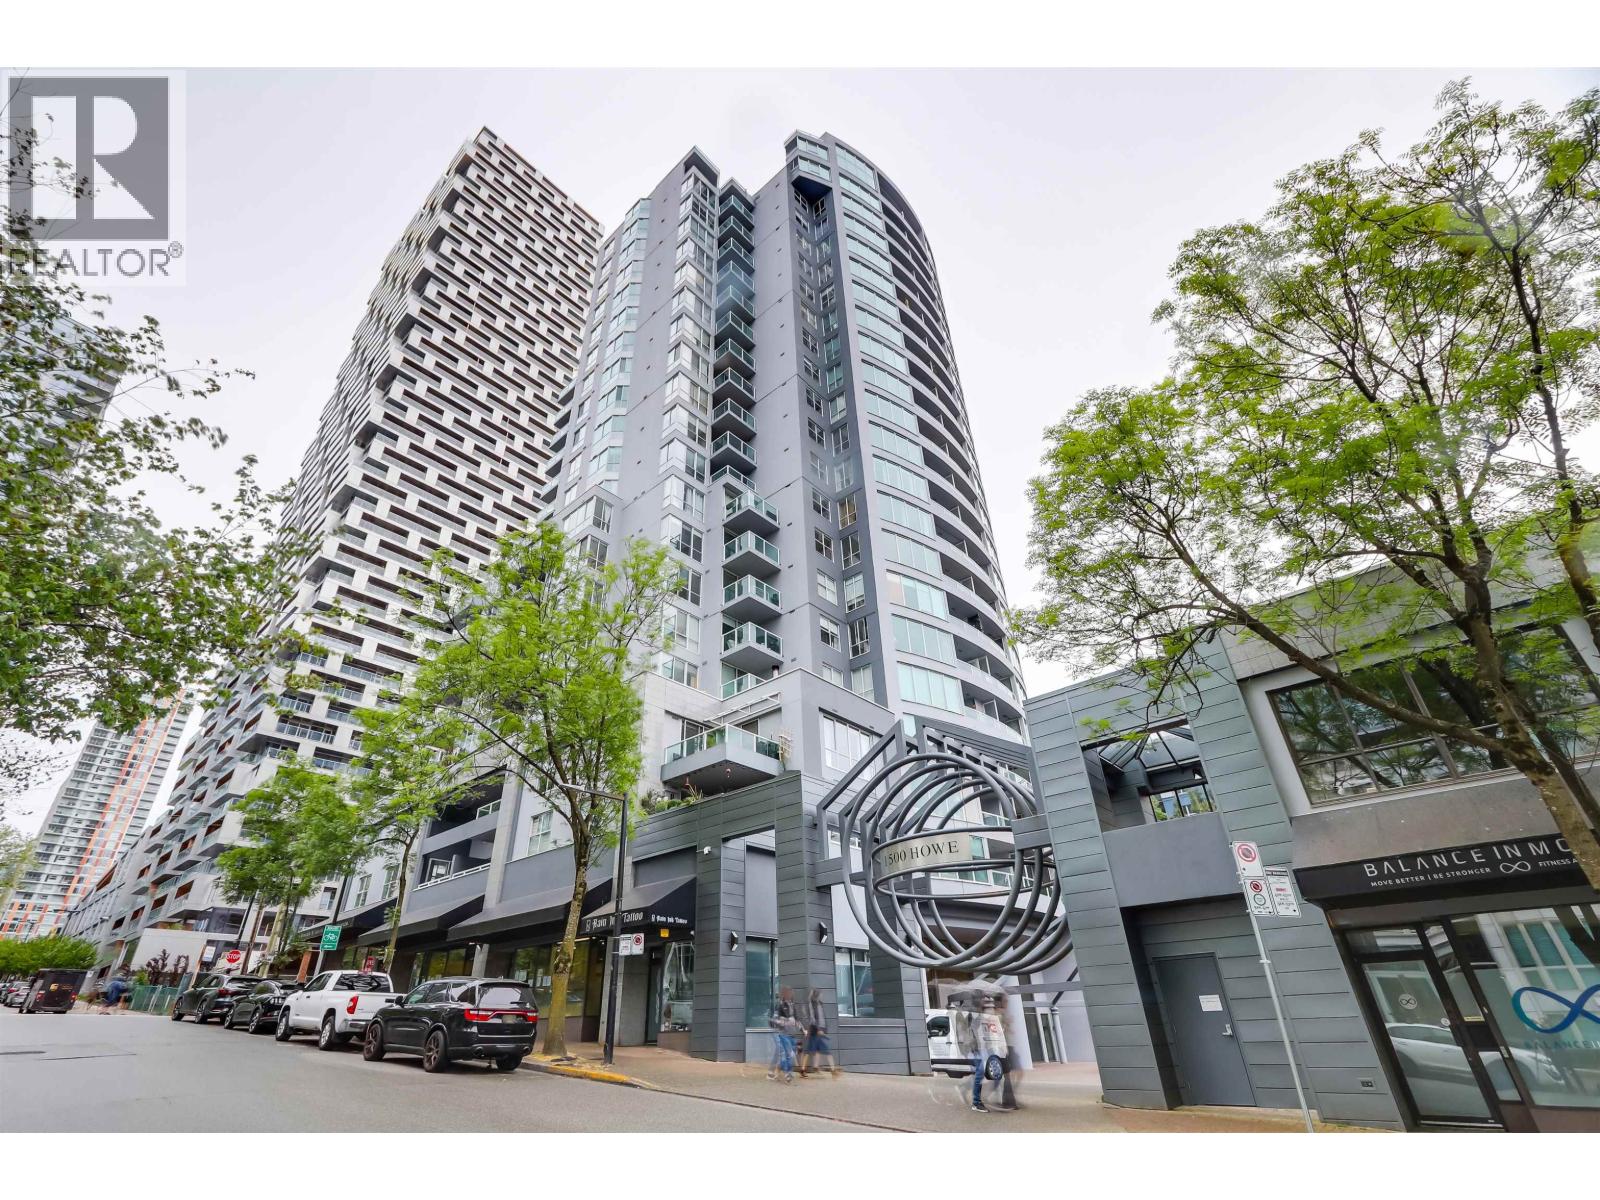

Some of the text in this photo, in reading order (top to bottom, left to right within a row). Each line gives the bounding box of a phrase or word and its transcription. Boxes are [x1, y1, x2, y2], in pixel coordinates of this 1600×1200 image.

[884, 840, 959, 867] 1500 HOWE
[1363, 849, 1486, 877] BALANCE
[1492, 844, 1521, 860] IN
[1538, 859, 1571, 867] FITNESS
[1396, 875, 1425, 884] BETTER
[1445, 867, 1492, 878] STRONGER
